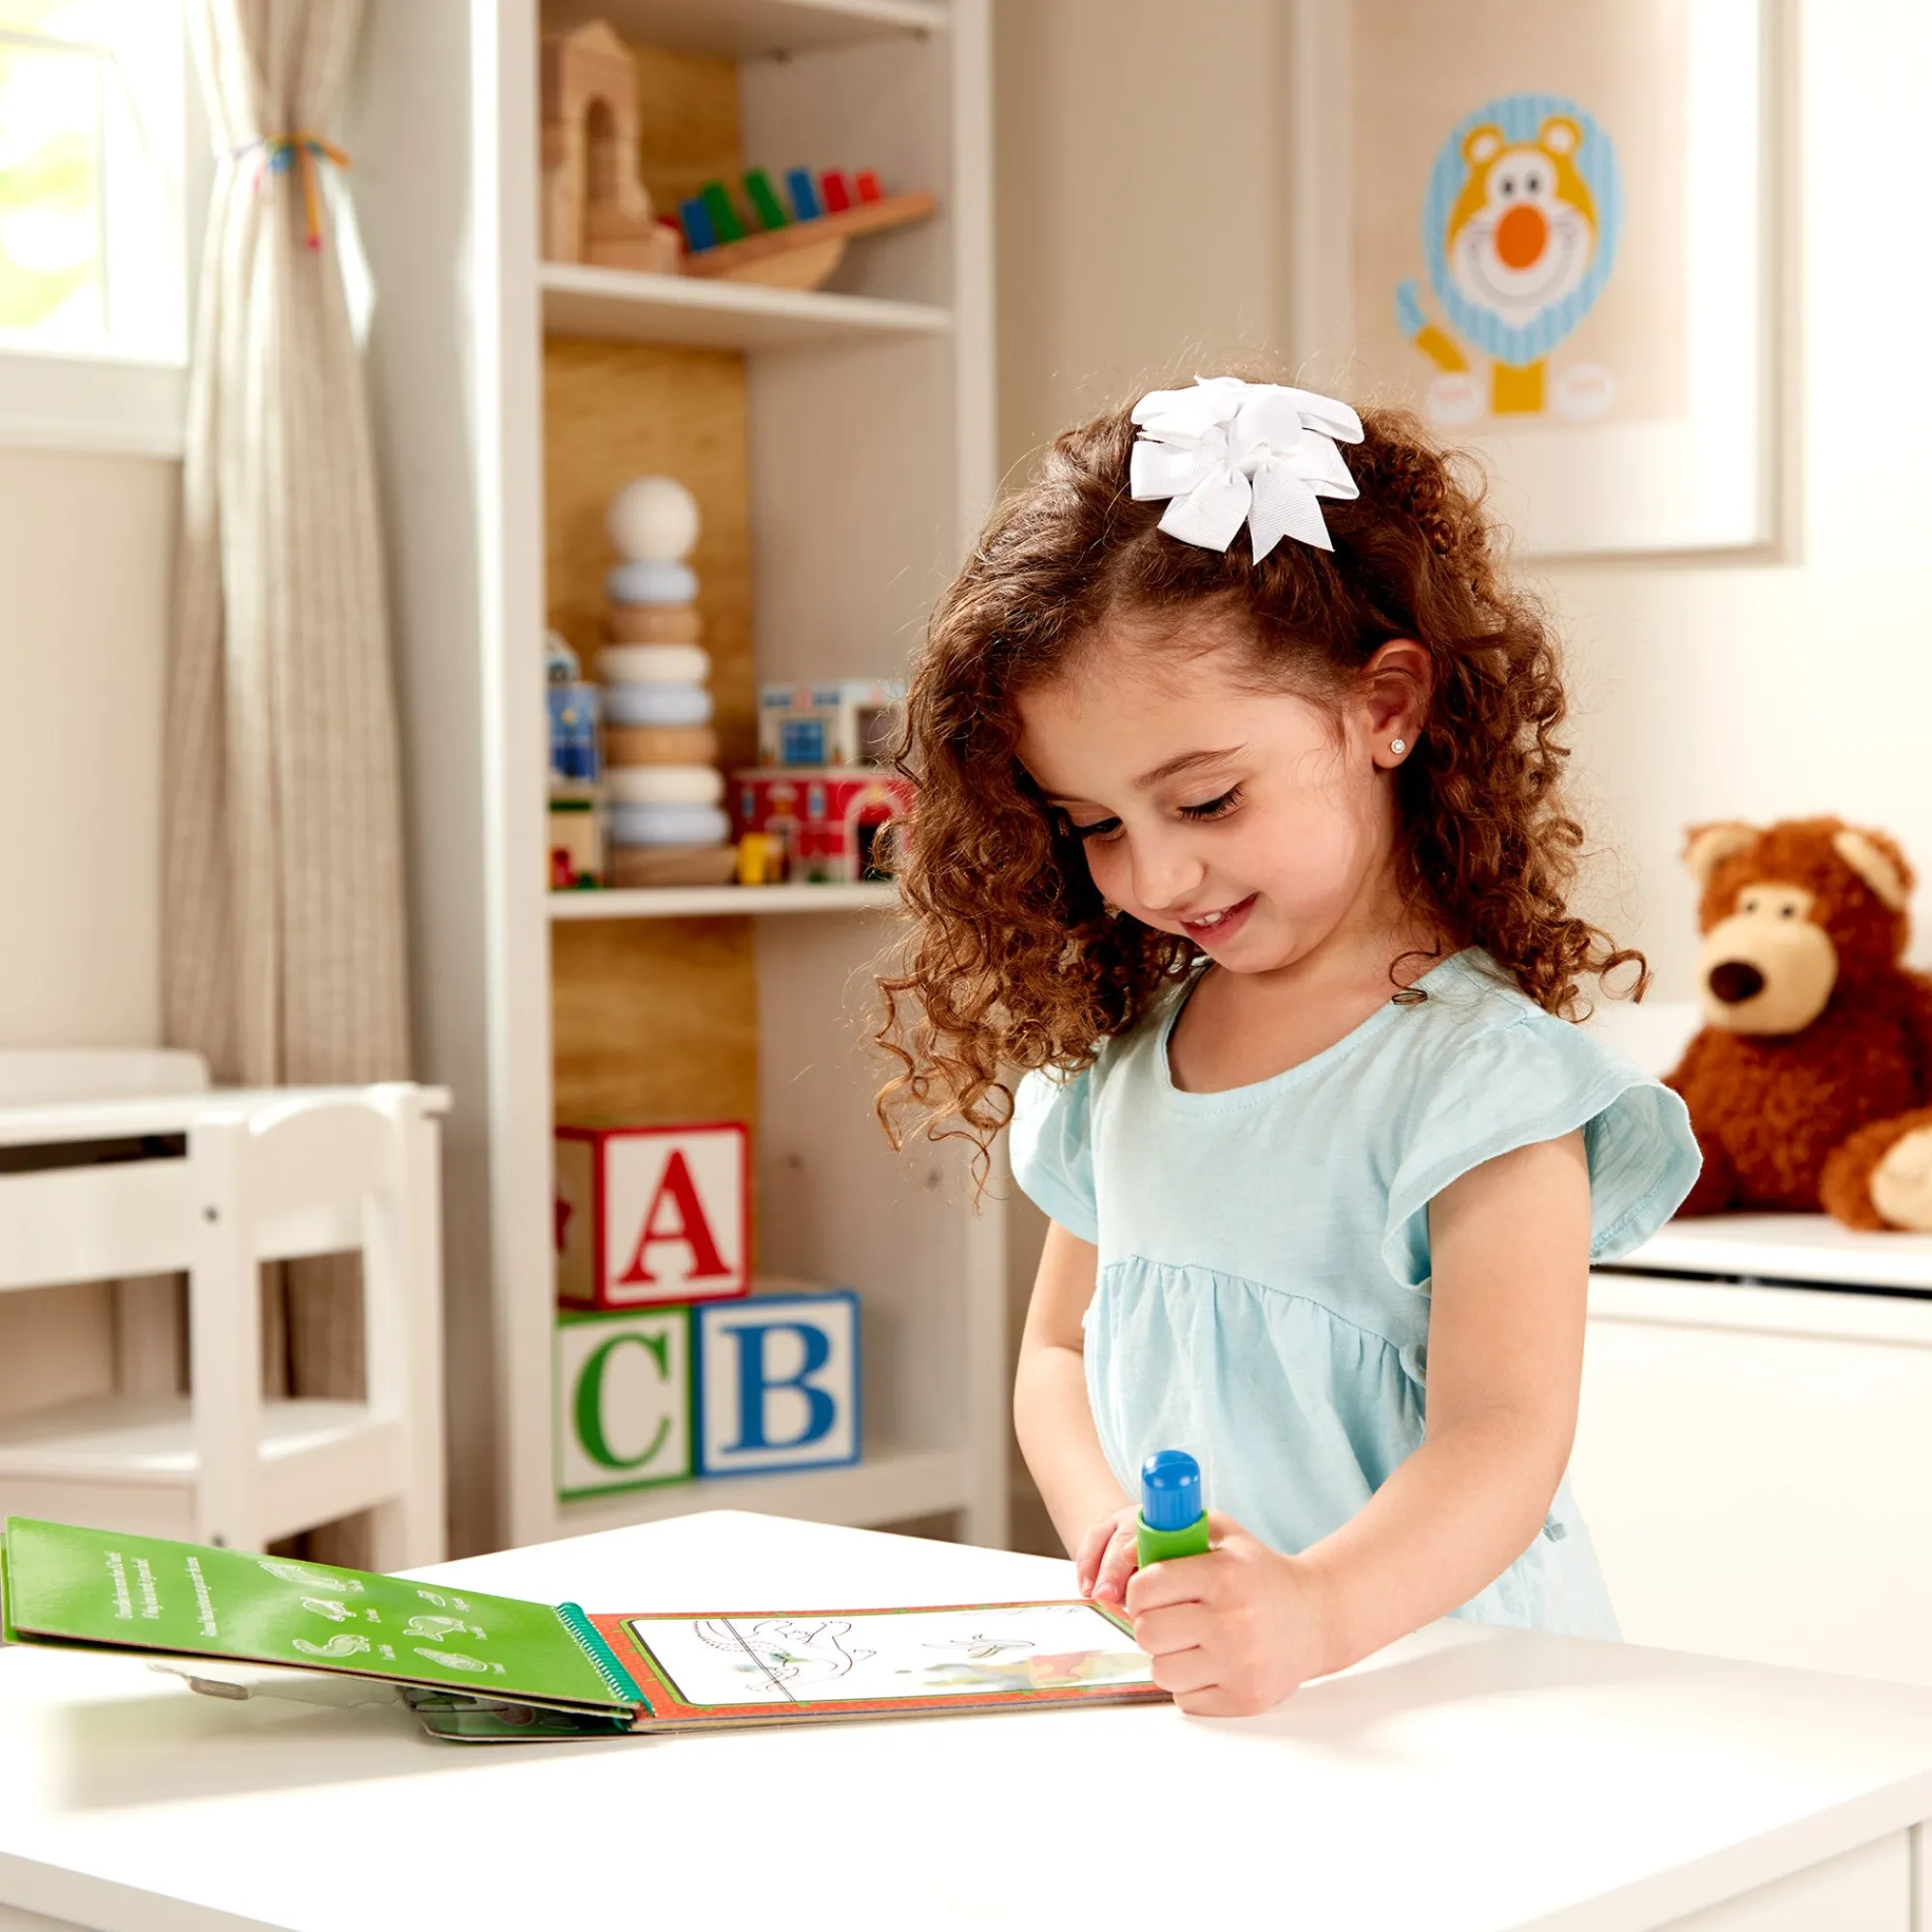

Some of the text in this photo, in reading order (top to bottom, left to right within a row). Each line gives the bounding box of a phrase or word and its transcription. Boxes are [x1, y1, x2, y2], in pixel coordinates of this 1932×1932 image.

[615, 1147, 734, 1285] A
[572, 1329, 671, 1471] C
[718, 1321, 838, 1455] B
